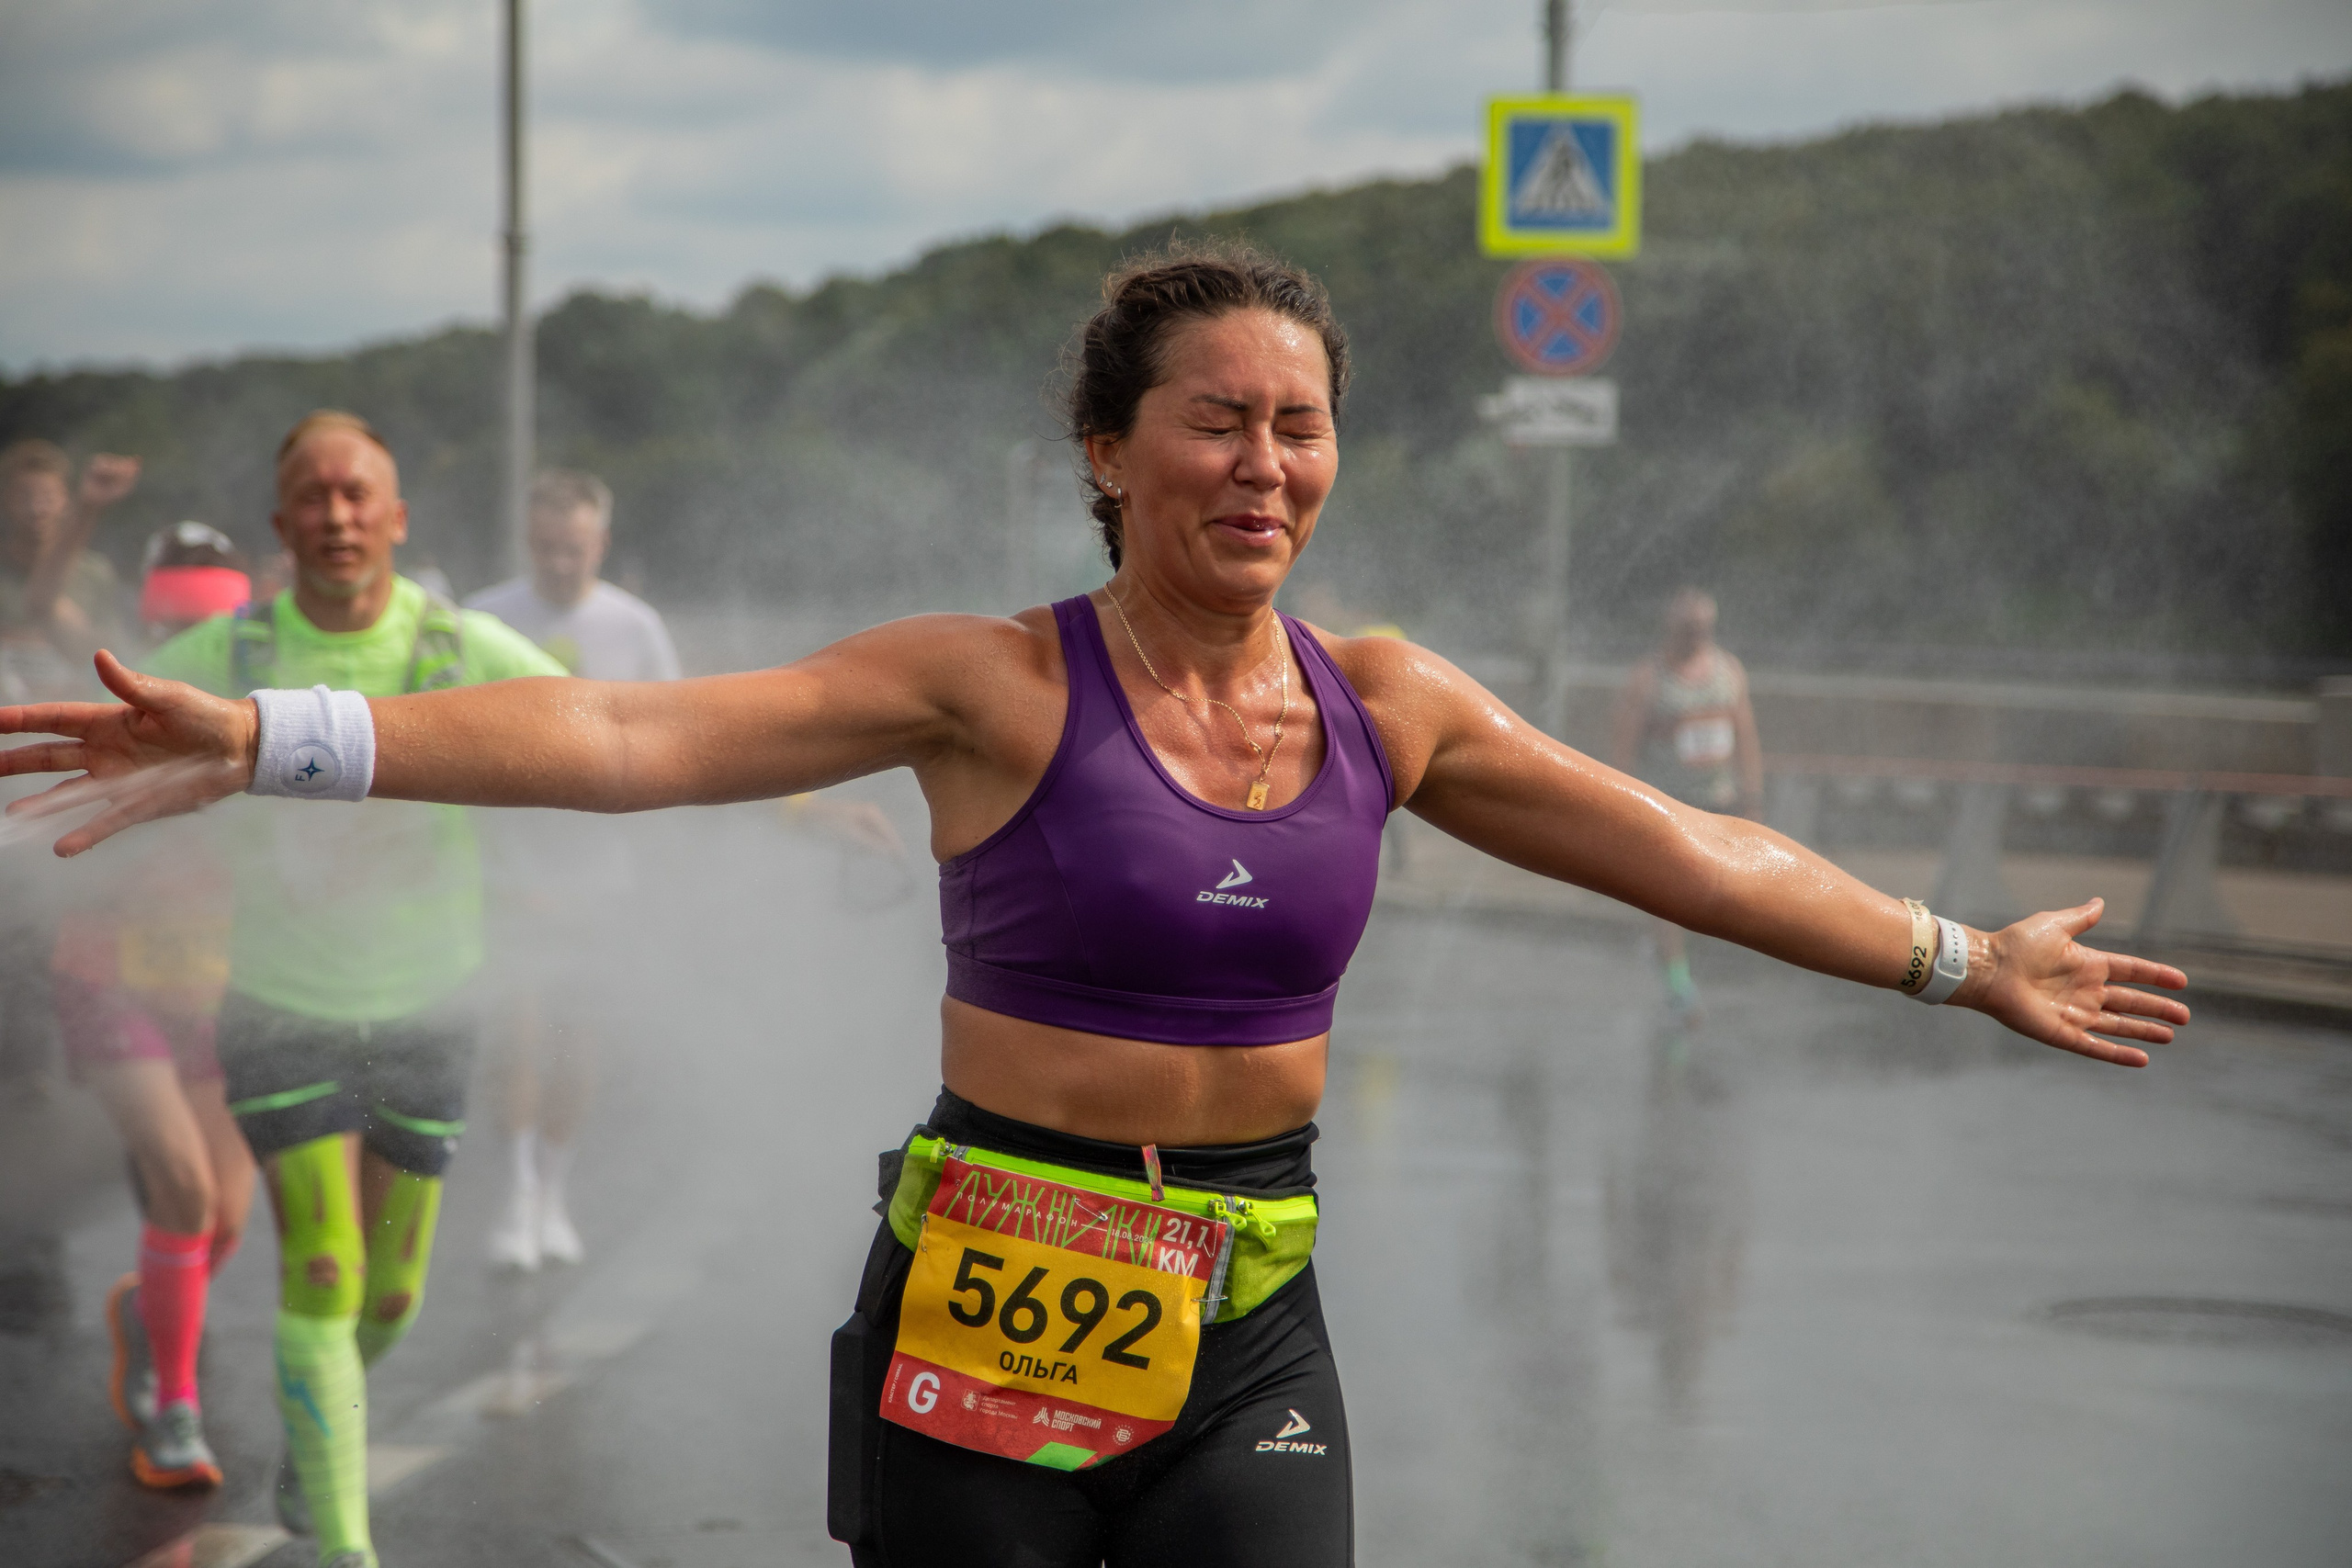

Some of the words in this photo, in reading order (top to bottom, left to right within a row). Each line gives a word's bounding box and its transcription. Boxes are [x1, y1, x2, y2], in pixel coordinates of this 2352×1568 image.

[1196, 890, 1270, 908] DEMIX
[1900, 945, 1928, 987] 5692
[943, 1170, 1162, 1269] ЛУЖНИКИ
[956, 1191, 1080, 1227] ПОЛУМАРАФОН
[1161, 1217, 1210, 1250] 21,1
[948, 1247, 1163, 1371] 5692
[999, 1350, 1079, 1385] ОЛЬГА
[908, 1371, 941, 1415] G
[1050, 1418, 1076, 1433] СПОРТ
[1053, 1409, 1102, 1430] МОСКОВСКИЙ
[1255, 1441, 1329, 1456] DEMIX
